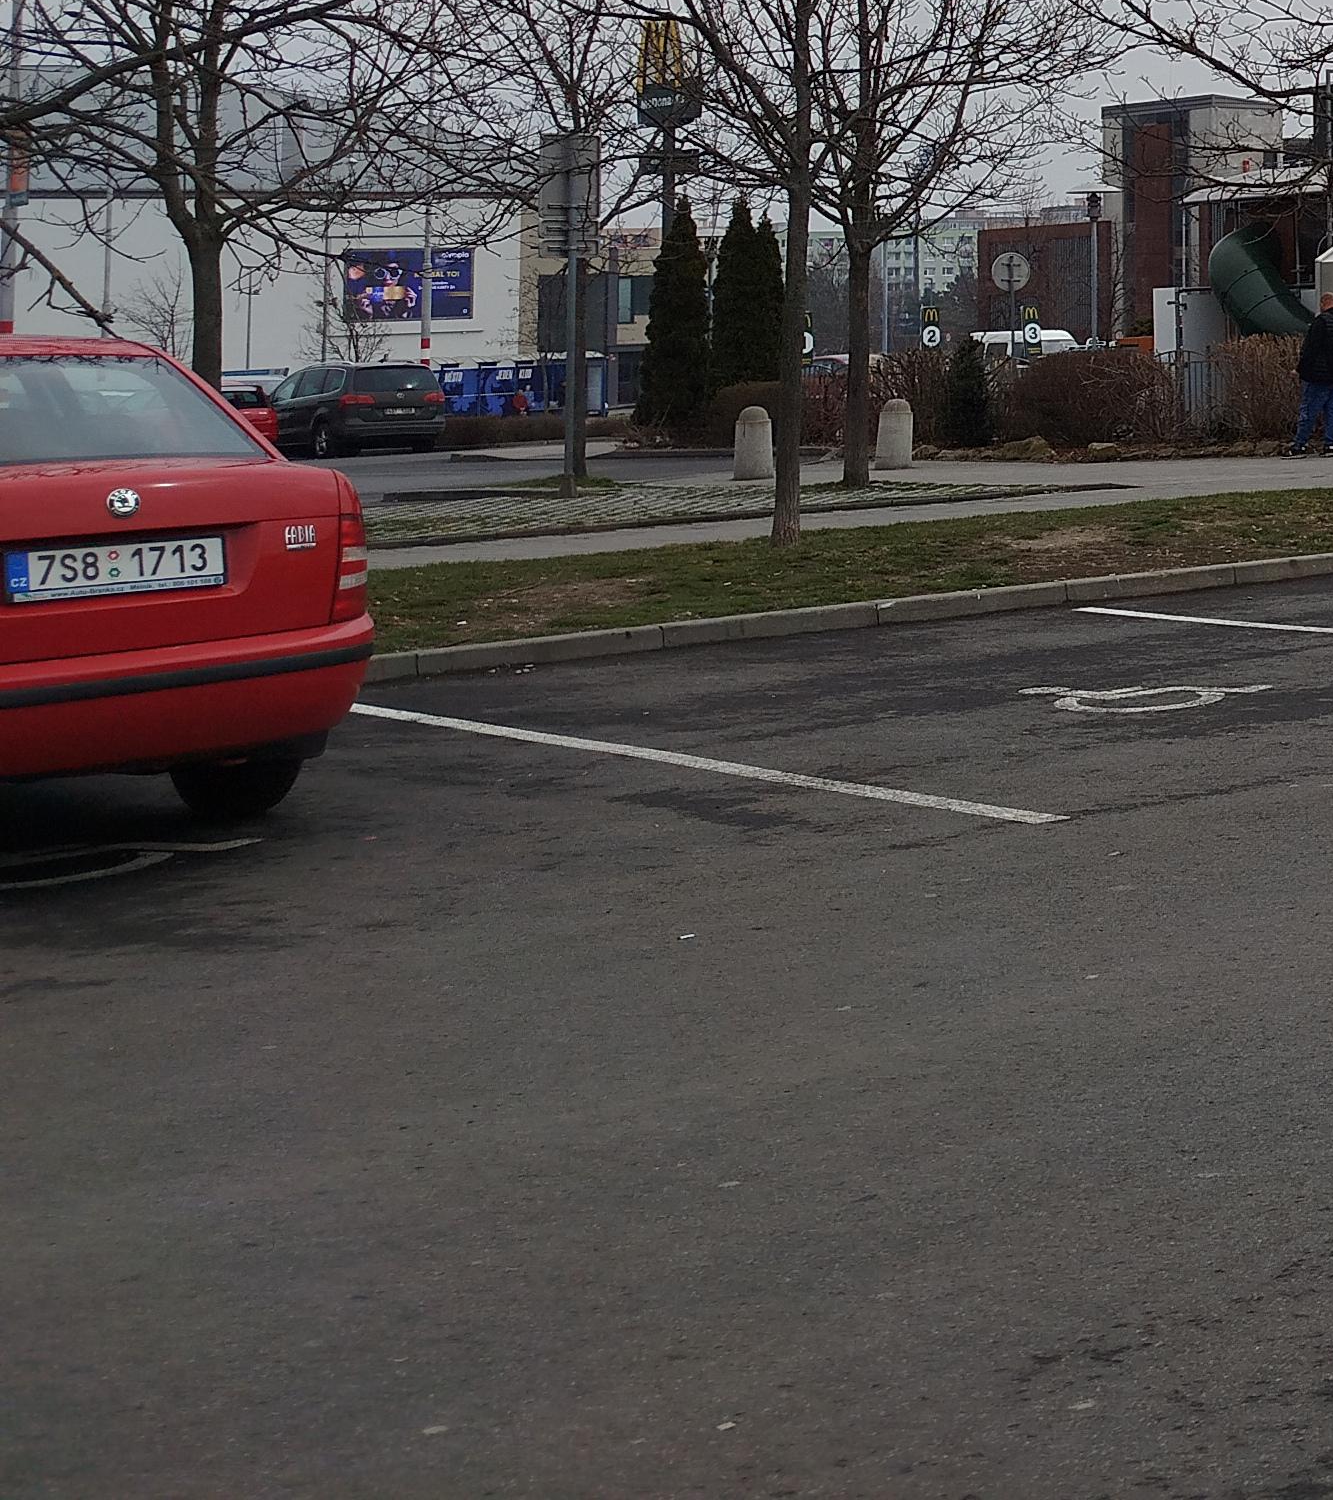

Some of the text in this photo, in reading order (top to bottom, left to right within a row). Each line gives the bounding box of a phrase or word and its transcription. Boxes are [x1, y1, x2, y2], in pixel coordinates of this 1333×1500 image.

[926, 330, 937, 343] 2
[1029, 326, 1038, 340] 3
[285, 524, 316, 544] FABIA
[37, 543, 208, 586] 7S8 1713
[10, 577, 28, 588] CZ
